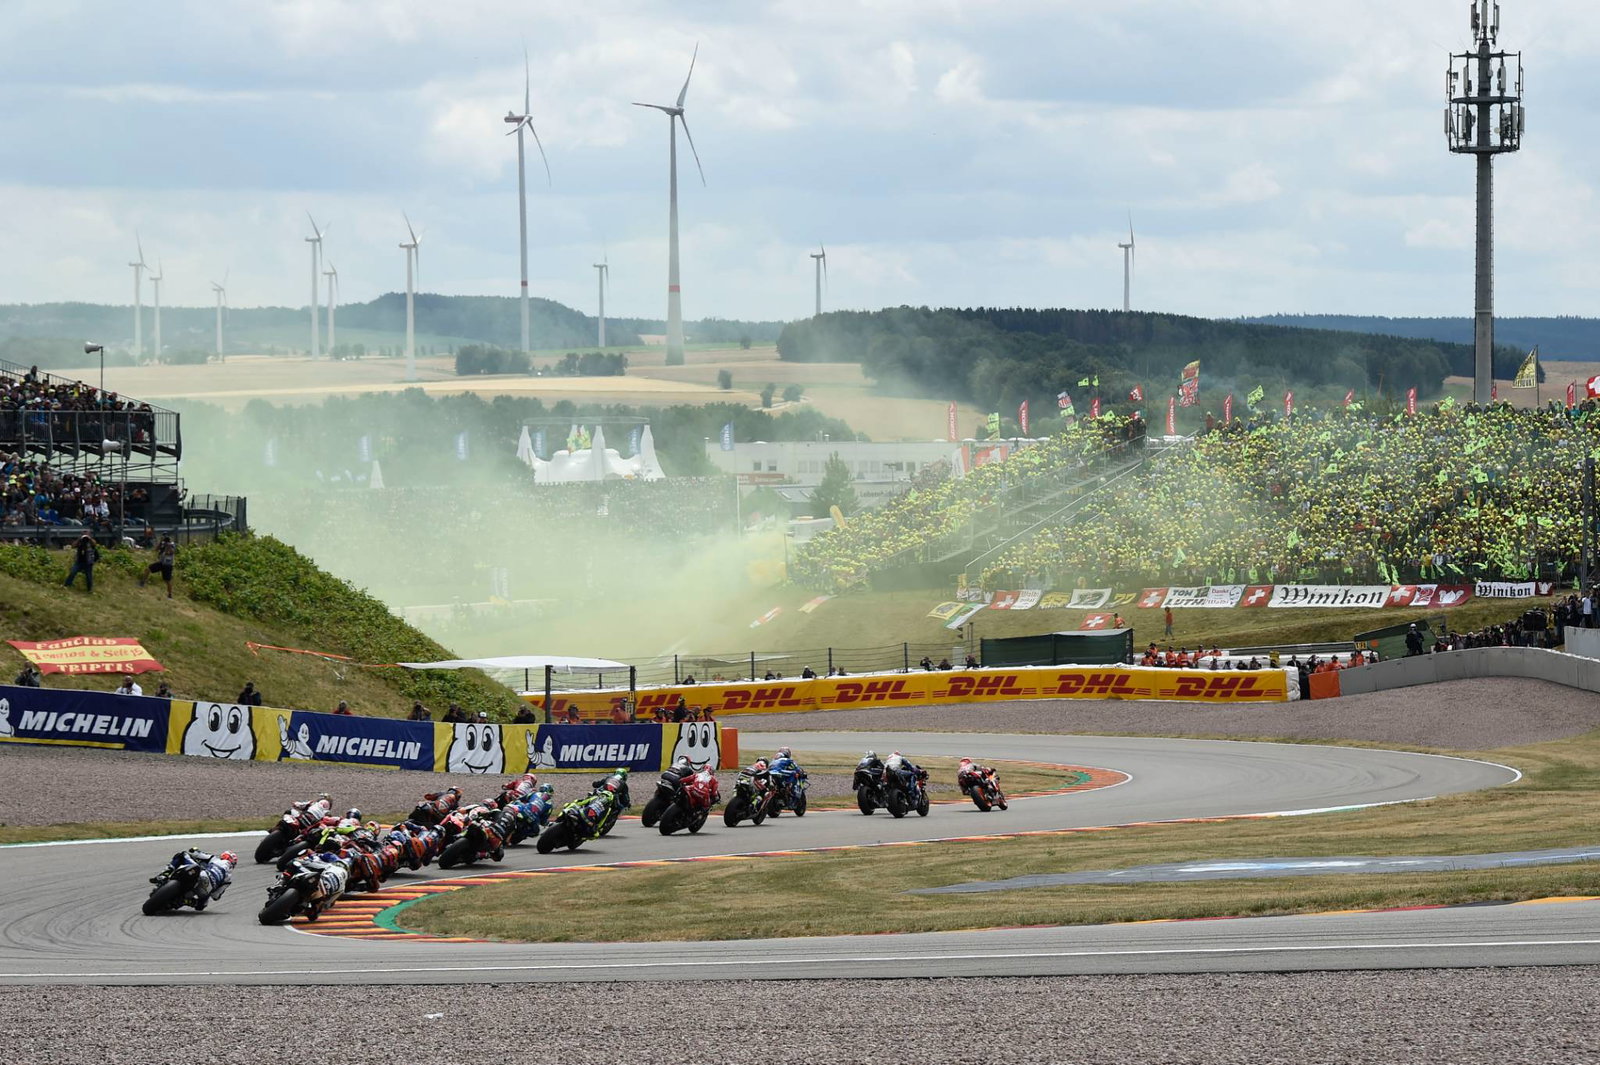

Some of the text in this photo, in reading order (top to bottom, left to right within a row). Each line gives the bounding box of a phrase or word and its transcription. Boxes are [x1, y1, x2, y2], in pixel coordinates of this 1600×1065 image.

[1279, 586, 1384, 605] Winikon
[1477, 583, 1531, 597] Winikon
[36, 637, 118, 650] Fanclub
[56, 662, 135, 672] TRIPTIS
[835, 680, 913, 703] DHL
[948, 675, 1024, 697] DHL
[1057, 673, 1136, 695] DHL
[1174, 676, 1265, 698] DHL
[722, 687, 802, 710] DHL
[18, 710, 154, 738] MICHELIN
[316, 735, 421, 760] MICHELIN
[559, 743, 650, 762] MICHELIN
